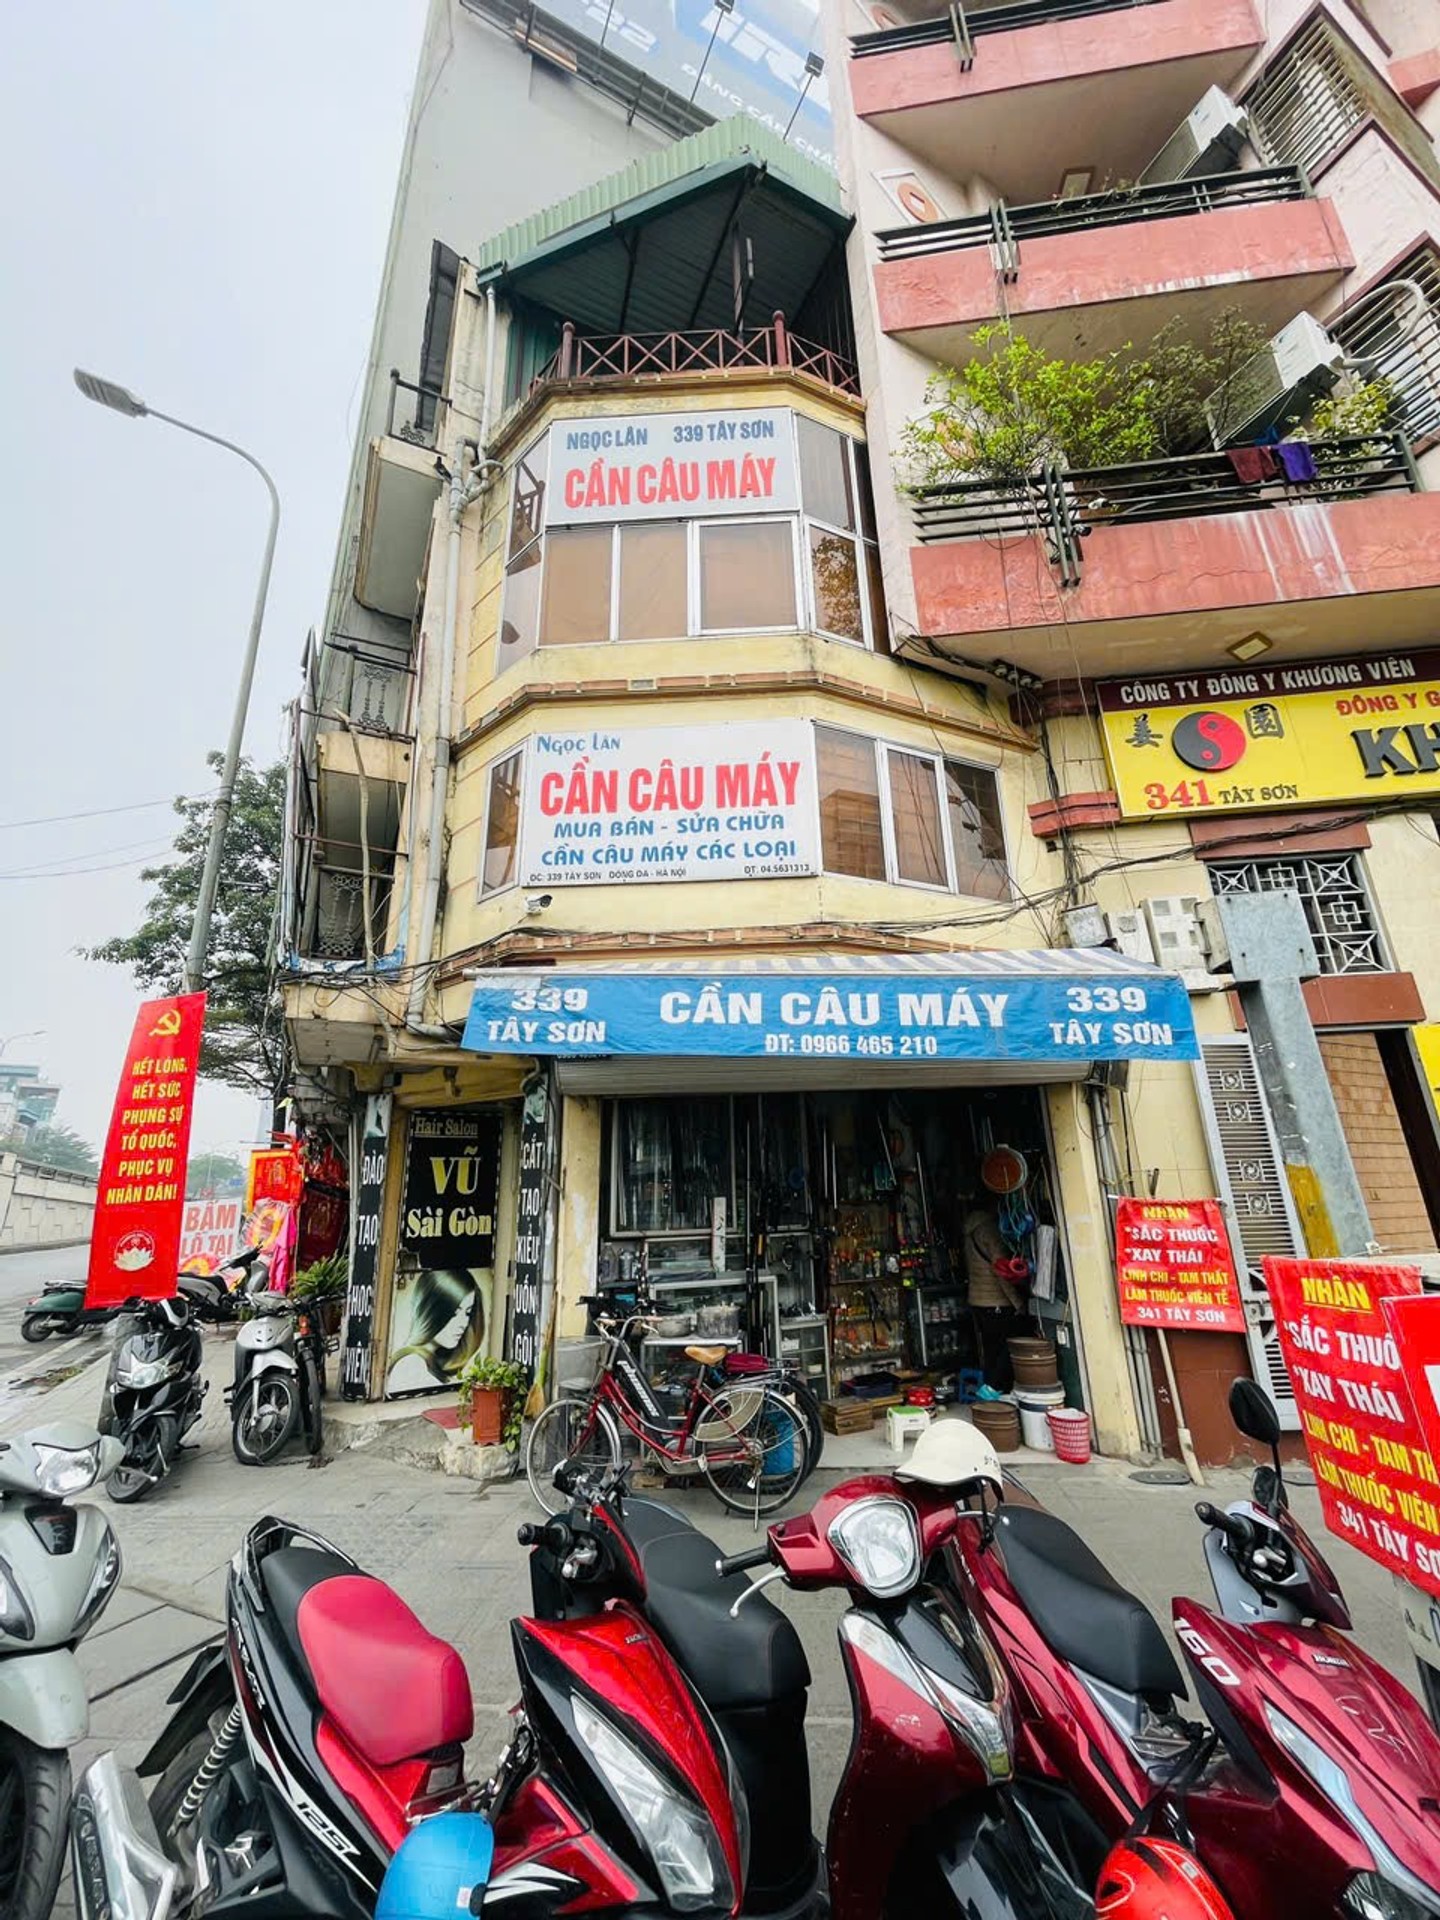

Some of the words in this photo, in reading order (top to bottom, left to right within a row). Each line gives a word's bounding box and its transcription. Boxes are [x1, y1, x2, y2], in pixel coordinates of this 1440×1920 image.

[567, 430, 613, 451] NGỌC
[616, 426, 648, 448] LÂN
[673, 424, 704, 444] 339
[707, 420, 736, 441] TÂY
[740, 418, 774, 439] SƠN
[564, 458, 631, 509] CẦN
[636, 456, 701, 504] CÂU
[706, 452, 776, 500] MÁY
[1120, 682, 1172, 705] CÔNG
[1174, 680, 1200, 699] TY
[1206, 675, 1259, 697] ĐÔNG
[1262, 673, 1277, 691] Y
[1282, 663, 1363, 690] KHƯƠNG
[1365, 658, 1417, 682] VIÊN
[1336, 694, 1400, 716] ĐÔNG
[1401, 692, 1418, 710] Y
[540, 756, 619, 816] CẦN
[628, 758, 704, 813] CÂU
[715, 751, 801, 809] MÁY
[1144, 779, 1214, 810] 341
[1218, 786, 1255, 804] TÂY
[1261, 783, 1299, 801] SƠN
[554, 820, 601, 838] MUA
[610, 816, 655, 837] BÁN
[677, 812, 720, 834] SỬA
[726, 809, 785, 831] CHỮA
[541, 843, 584, 866] CẦN
[592, 844, 634, 865] CÂU
[641, 840, 689, 863] MÁY
[696, 840, 736, 860] CÁC
[744, 841, 796, 861] LOẠI
[546, 872, 562, 882] 339
[511, 987, 588, 1013] 339
[660, 981, 763, 1026] CẦN
[780, 985, 881, 1027] CÂU
[899, 985, 1010, 1028] MÁY
[1066, 986, 1148, 1014] 339
[487, 1016, 543, 1043] TÂY
[548, 1018, 607, 1044] SƠN
[764, 1034, 796, 1054] ĐT:
[801, 1034, 851, 1055] 0966
[856, 1035, 895, 1056] 465
[900, 1036, 938, 1056] 210
[1049, 1018, 1102, 1046] TÂY
[1111, 1020, 1174, 1047] SƠN
[132, 1056, 154, 1075] HẾT
[132, 1080, 155, 1100] HẾT
[157, 1080, 182, 1099] SỨC
[122, 1108, 168, 1128] PHỤNG
[169, 1104, 185, 1126] SỰ
[415, 1116, 444, 1135] Hair
[445, 1117, 479, 1135] Salon
[121, 1129, 140, 1151] TỔ
[523, 1132, 542, 1170] CẮT
[118, 1159, 155, 1180] PHỤC
[157, 1157, 174, 1177] VỤ
[363, 1149, 385, 1185] ĐÀO
[428, 1145, 482, 1195] VŨ
[106, 1183, 143, 1206] NHÂN
[145, 1181, 178, 1202] DÂN!
[520, 1188, 540, 1222] TẠO
[184, 1201, 238, 1232] BẤM
[406, 1205, 444, 1239] Sài
[448, 1205, 492, 1238] Gòn
[358, 1213, 379, 1252] TẠO
[1167, 1247, 1203, 1264] THÁI
[1150, 1270, 1169, 1283] CHI
[1178, 1270, 1200, 1285] TAM
[350, 1284, 373, 1323] HỌC
[515, 1273, 537, 1315] UỐN
[1301, 1276, 1372, 1313] NHẬN
[1137, 1306, 1162, 1320] 341
[1165, 1306, 1192, 1322] TÂY
[1195, 1308, 1226, 1324] SƠN
[345, 1340, 369, 1384] VIÊN
[1336, 1379, 1405, 1423] THÁI
[1328, 1421, 1360, 1456] CHI
[1370, 1433, 1412, 1475] TAM
[1313, 1450, 1344, 1491] LÀM
[1338, 1471, 1395, 1515] THUỐC
[1395, 1488, 1440, 1536] VIÊN
[1336, 1500, 1369, 1540] 341
[1369, 1517, 1410, 1563] TÂY
[1174, 1616, 1242, 1686] 160
